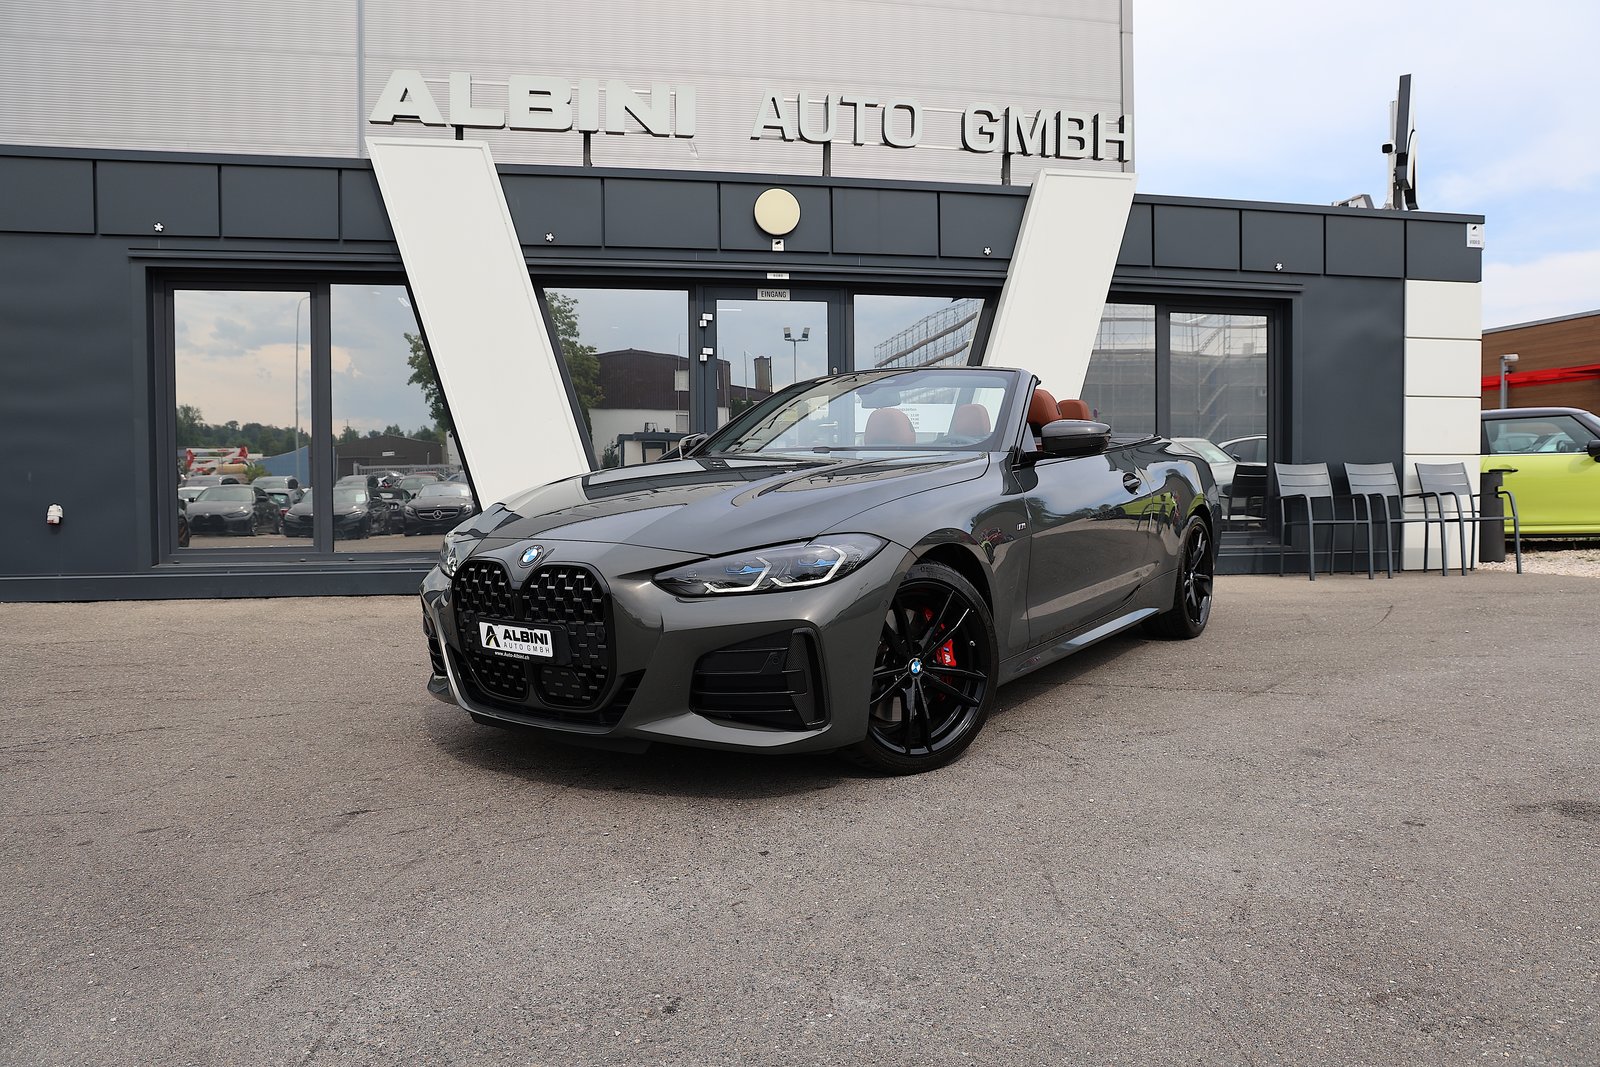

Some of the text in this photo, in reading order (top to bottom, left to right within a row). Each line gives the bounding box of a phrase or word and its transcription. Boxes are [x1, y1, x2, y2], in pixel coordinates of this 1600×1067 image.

[369, 69, 1133, 162] ALBINI AUTO GMBH
[503, 629, 548, 645] ALBINI
[503, 642, 550, 654] AUTO GMBH
